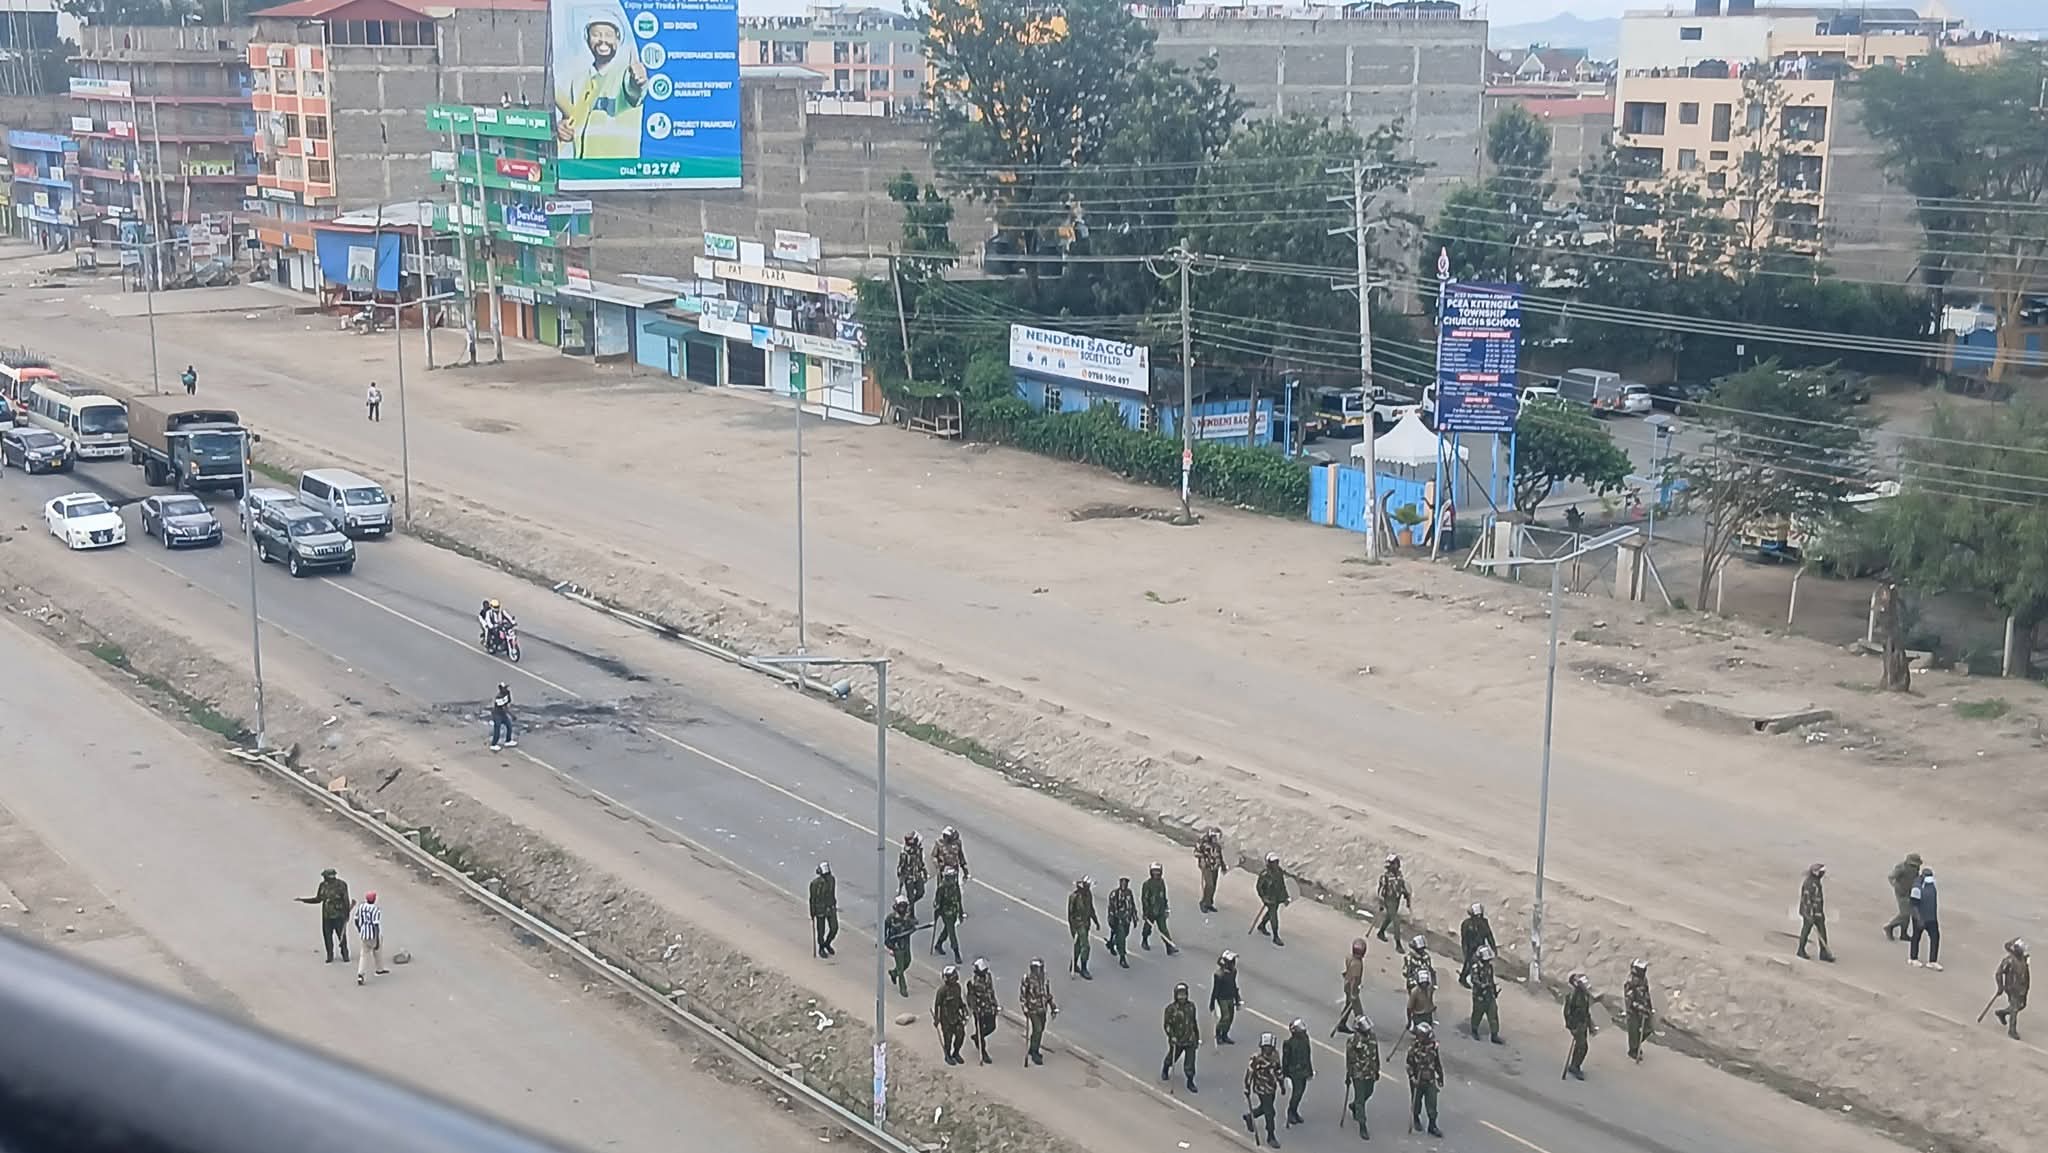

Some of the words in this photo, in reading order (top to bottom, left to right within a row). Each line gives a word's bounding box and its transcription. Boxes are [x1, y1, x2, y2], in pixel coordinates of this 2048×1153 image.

[761, 268, 786, 282] PLAZA
[1447, 298, 1469, 308] PCEA
[1470, 299, 1519, 310] KITENGELA
[1459, 308, 1507, 318] TOWNSHIP
[1443, 316, 1479, 327] CHURCH
[1486, 318, 1521, 328] SCHOOL
[1025, 329, 1084, 349] NENDENI
[1087, 340, 1135, 358] SACCO
[1080, 350, 1109, 365] SOCIETY
